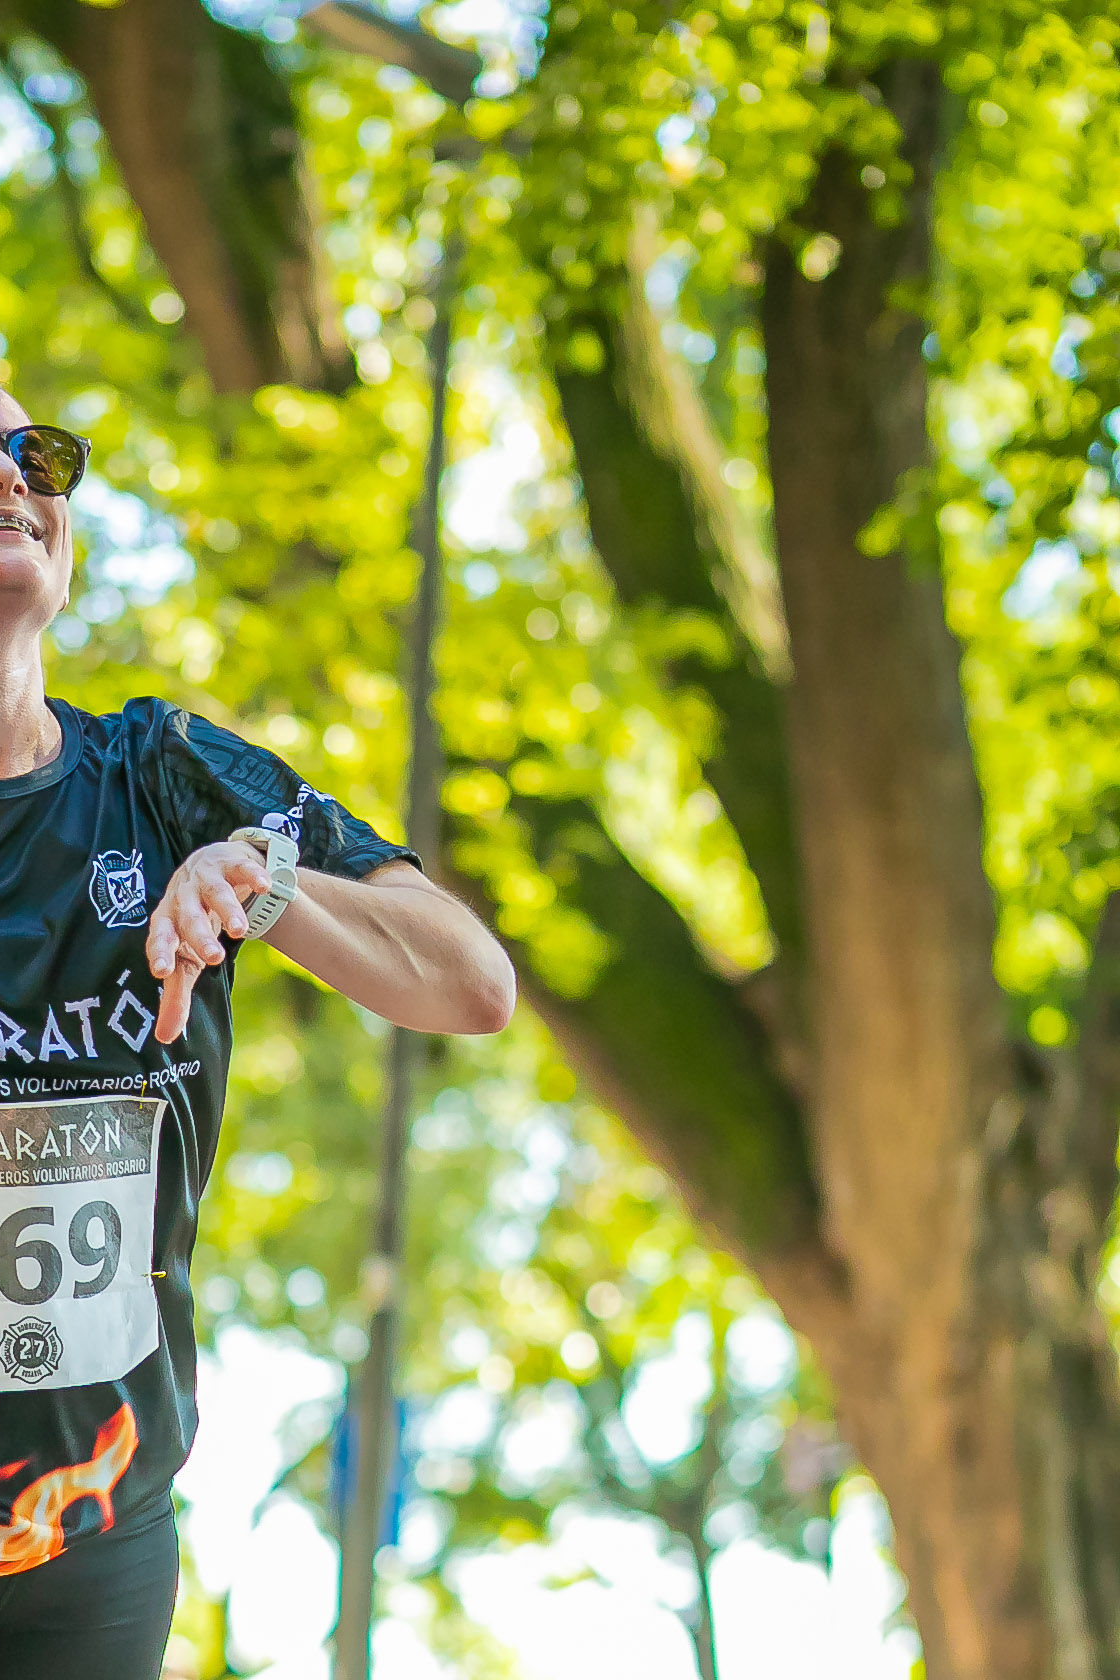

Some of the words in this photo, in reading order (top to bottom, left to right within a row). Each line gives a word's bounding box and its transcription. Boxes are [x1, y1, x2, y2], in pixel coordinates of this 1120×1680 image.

[14, 1073, 144, 1097] VOLUNTARIOS
[32, 1163, 104, 1184] VOLUNTARIOS
[105, 1158, 146, 1175] ROSARIO
[19, 1337, 45, 1360] 27
